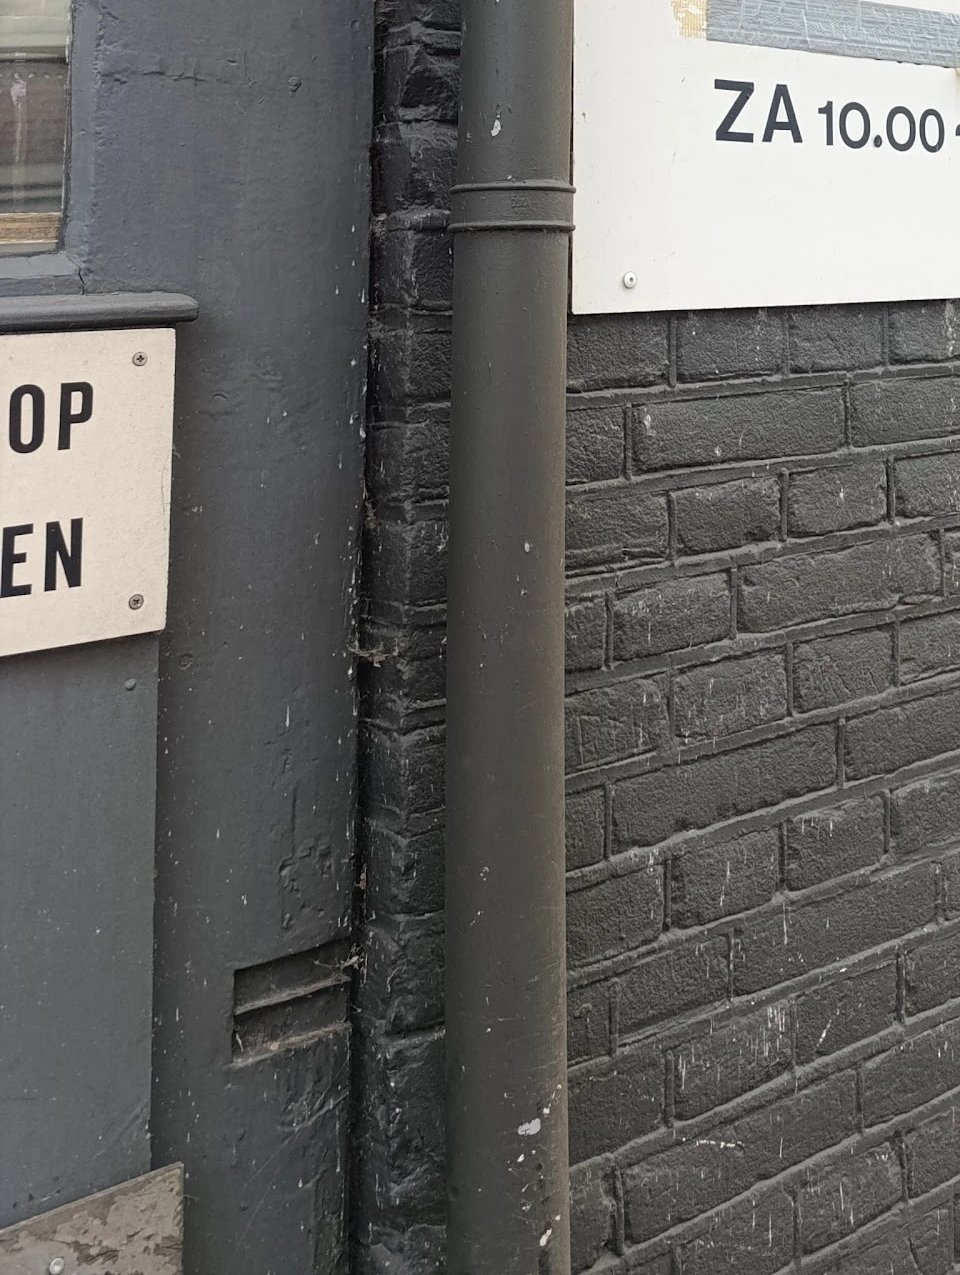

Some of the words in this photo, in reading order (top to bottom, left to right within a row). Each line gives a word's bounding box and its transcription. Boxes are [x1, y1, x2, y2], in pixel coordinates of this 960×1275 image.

[714, 78, 803, 144] ZA
[8, 381, 94, 454] OP
[0, 517, 84, 599] EN
